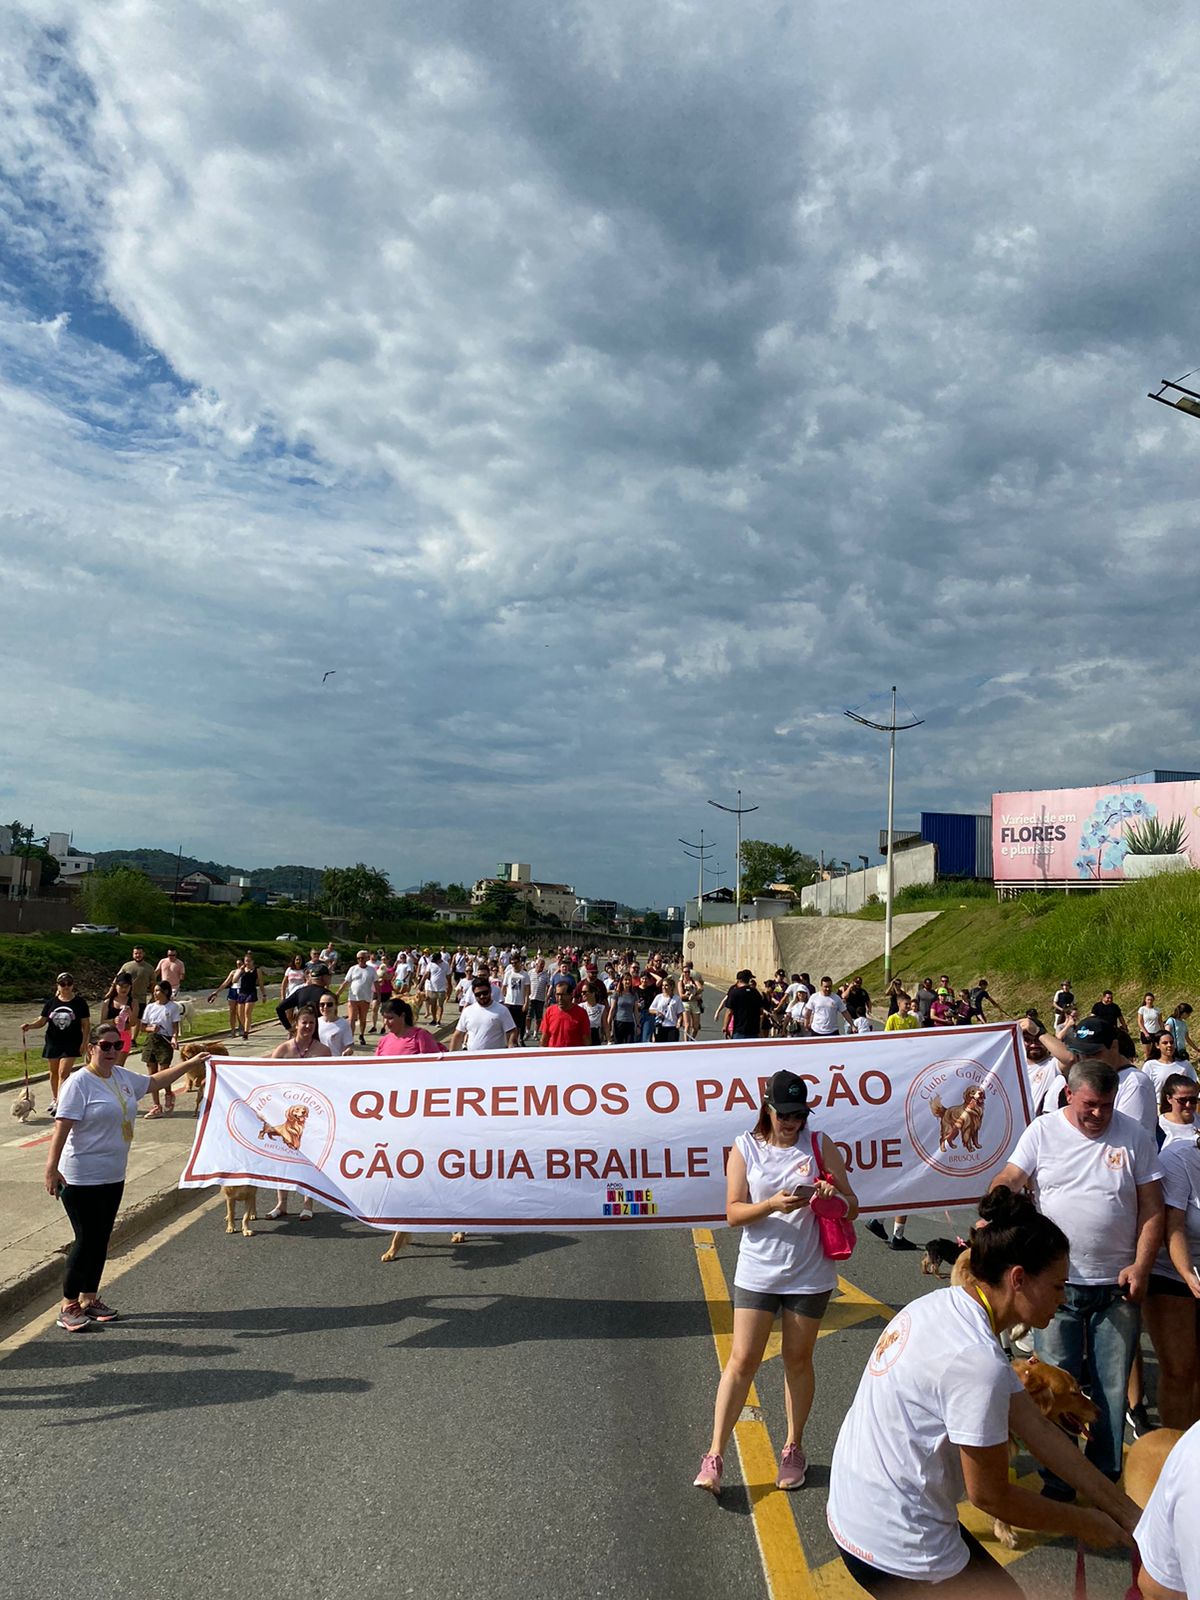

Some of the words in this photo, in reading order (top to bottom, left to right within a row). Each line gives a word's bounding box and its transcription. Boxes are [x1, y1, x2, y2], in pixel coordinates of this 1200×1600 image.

[1058, 814, 1076, 822] em
[1001, 825, 1067, 843] FLORES
[349, 1082, 630, 1120] QUEREMOS
[645, 1080, 680, 1114] O
[696, 1064, 893, 1112] PACÃO
[282, 1090, 325, 1116] Goldens
[339, 1142, 425, 1180] CÃO
[437, 1149, 535, 1180] GUIA
[546, 1147, 711, 1180] BRAILLE
[607, 1188, 653, 1202] ANDRÉ
[603, 1203, 657, 1216] REZINI
